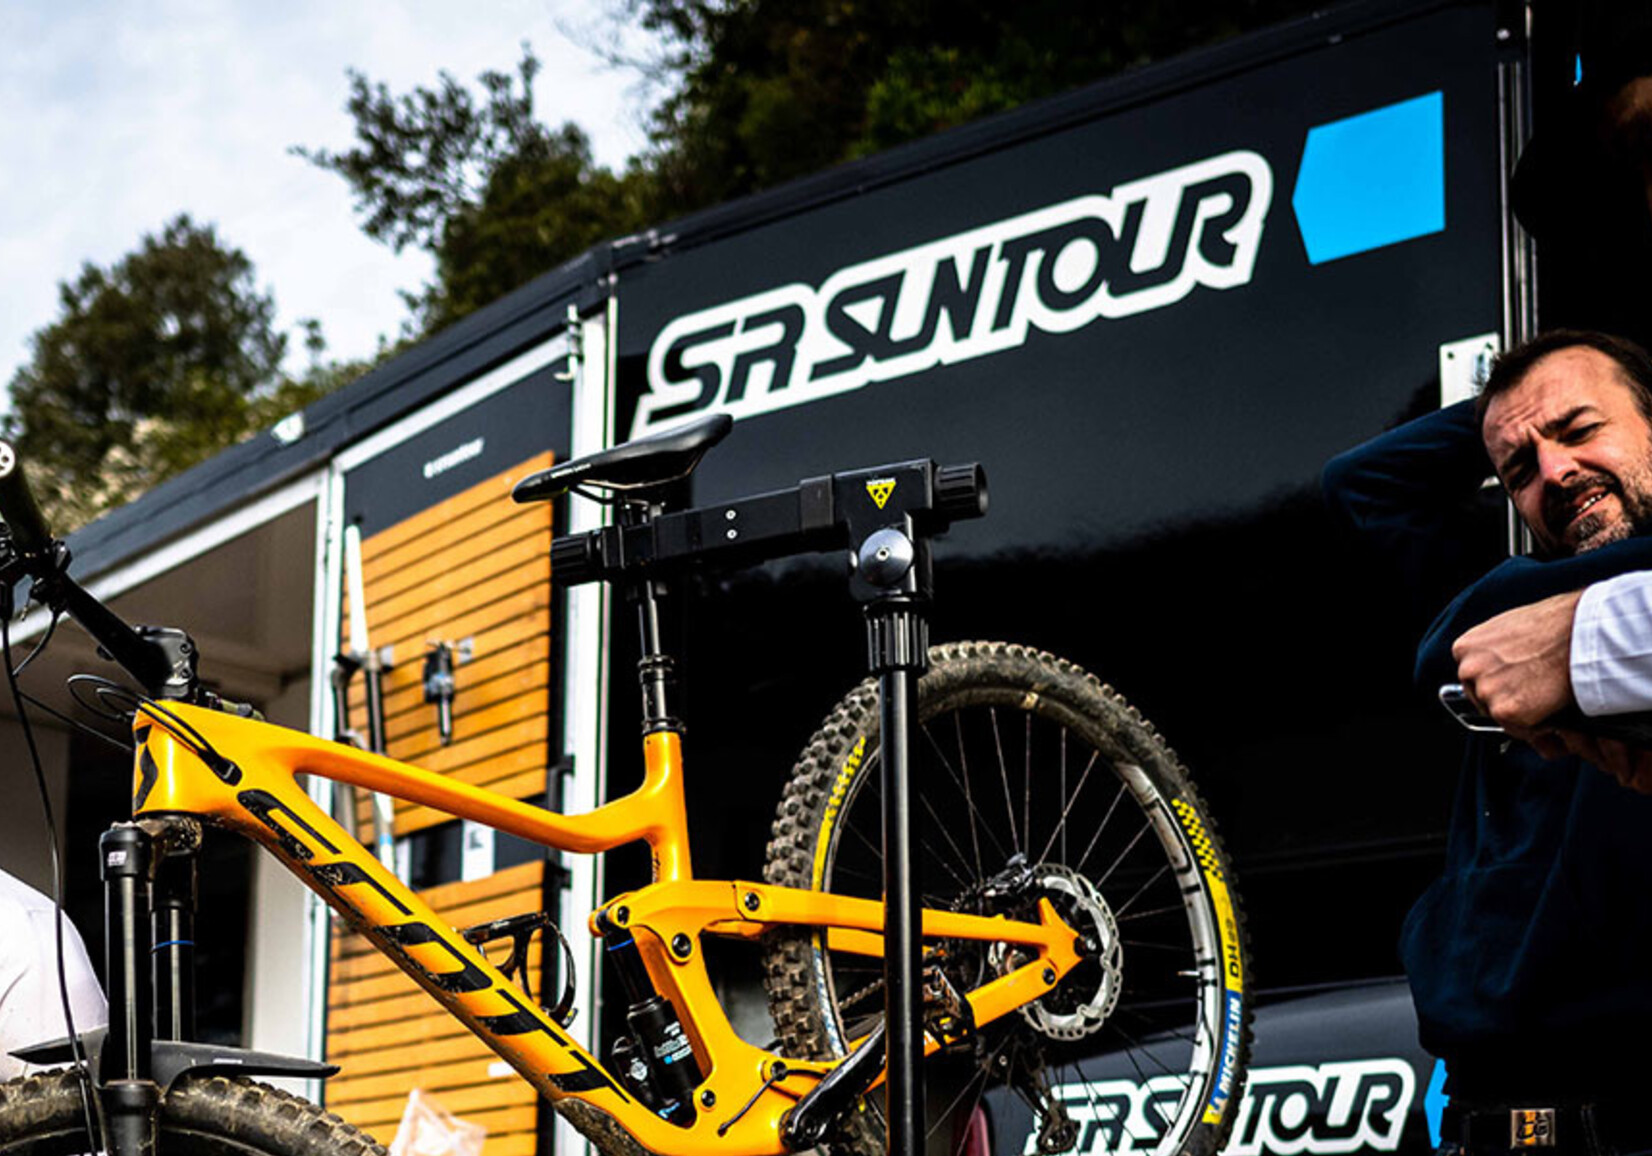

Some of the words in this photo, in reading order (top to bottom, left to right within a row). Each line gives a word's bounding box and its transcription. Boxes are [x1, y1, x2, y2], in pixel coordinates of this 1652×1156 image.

[642, 296, 810, 427] SR
[806, 165, 1256, 386] SUNTOUR
[236, 788, 634, 1104] SCOTT
[1218, 996, 1242, 1095] MICHELIN
